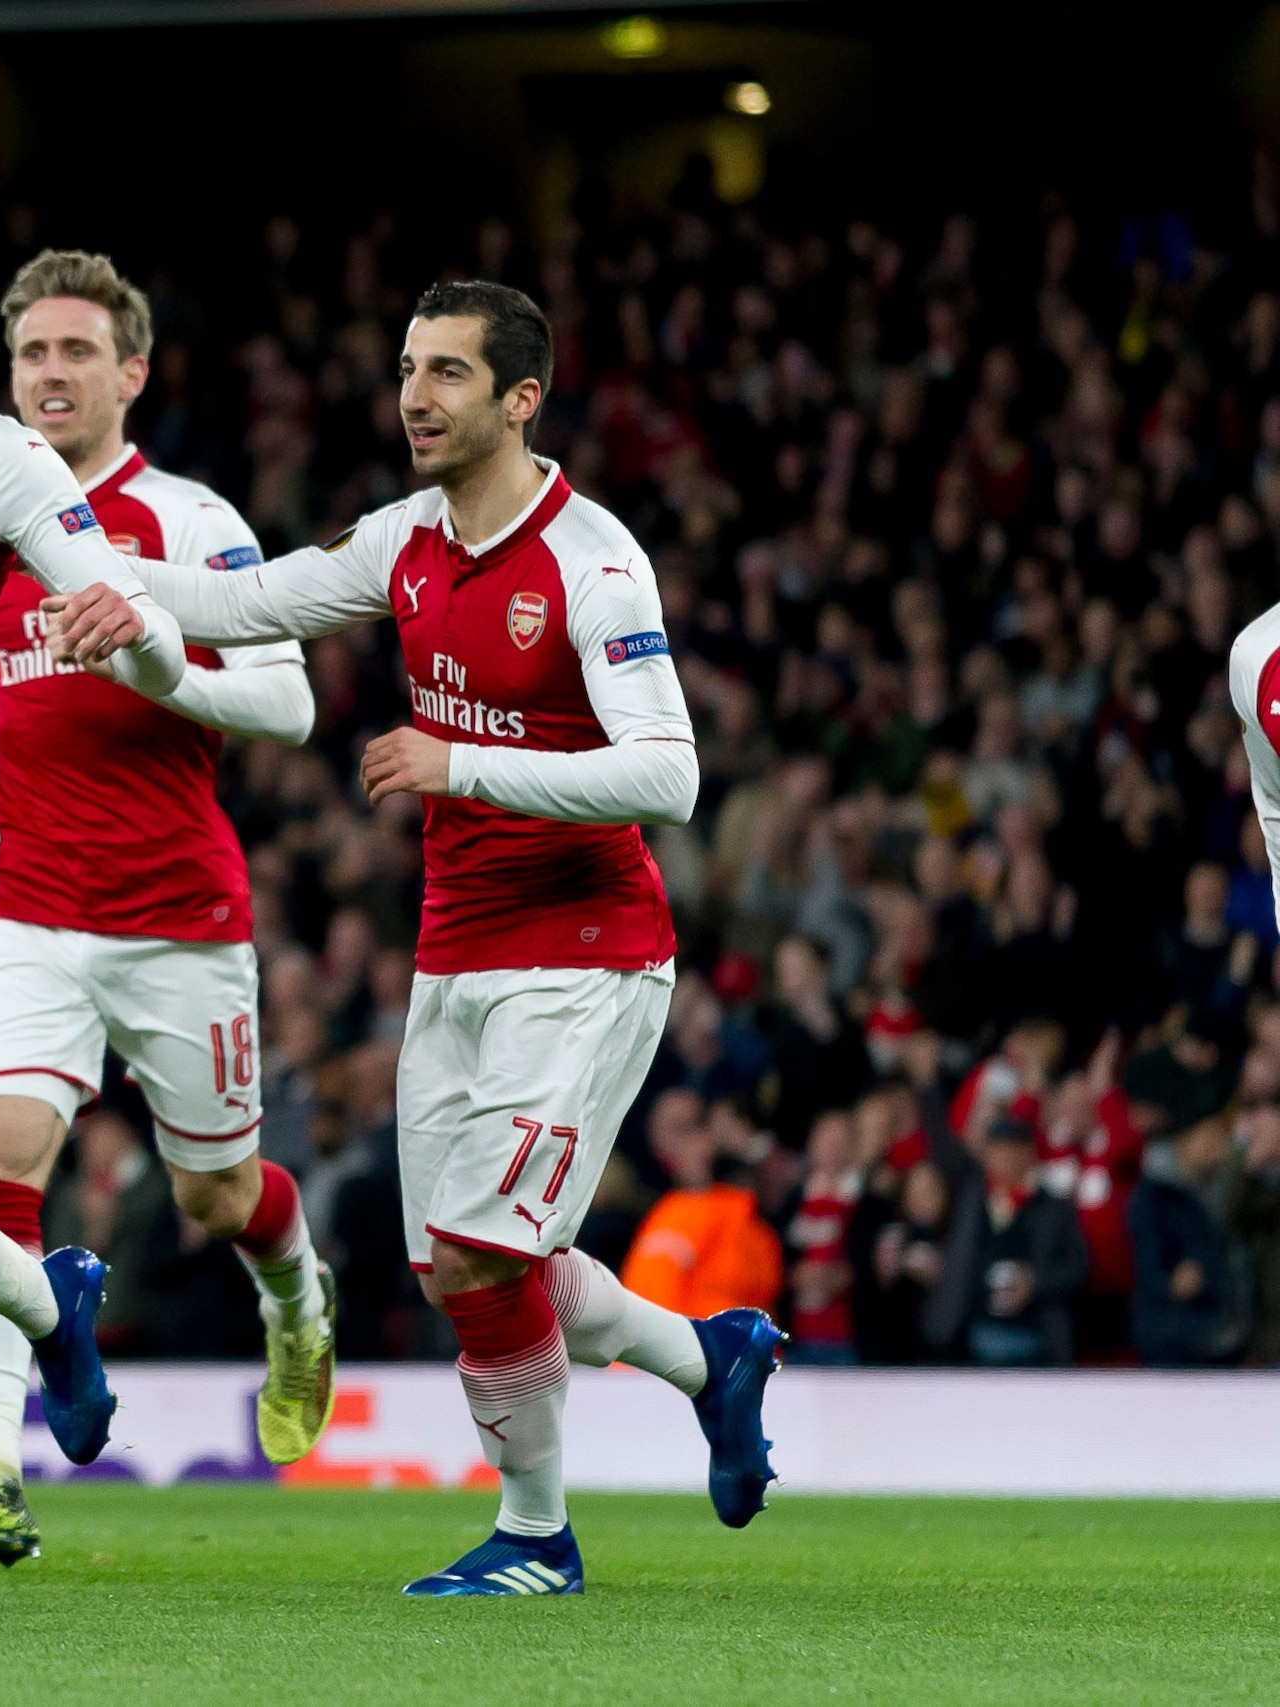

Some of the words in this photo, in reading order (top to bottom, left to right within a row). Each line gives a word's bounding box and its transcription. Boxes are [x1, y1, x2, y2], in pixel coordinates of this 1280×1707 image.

[23, 610, 49, 639] Fl
[433, 652, 467, 692] Fly
[209, 1013, 253, 1094] 18
[497, 1115, 579, 1204] 77
